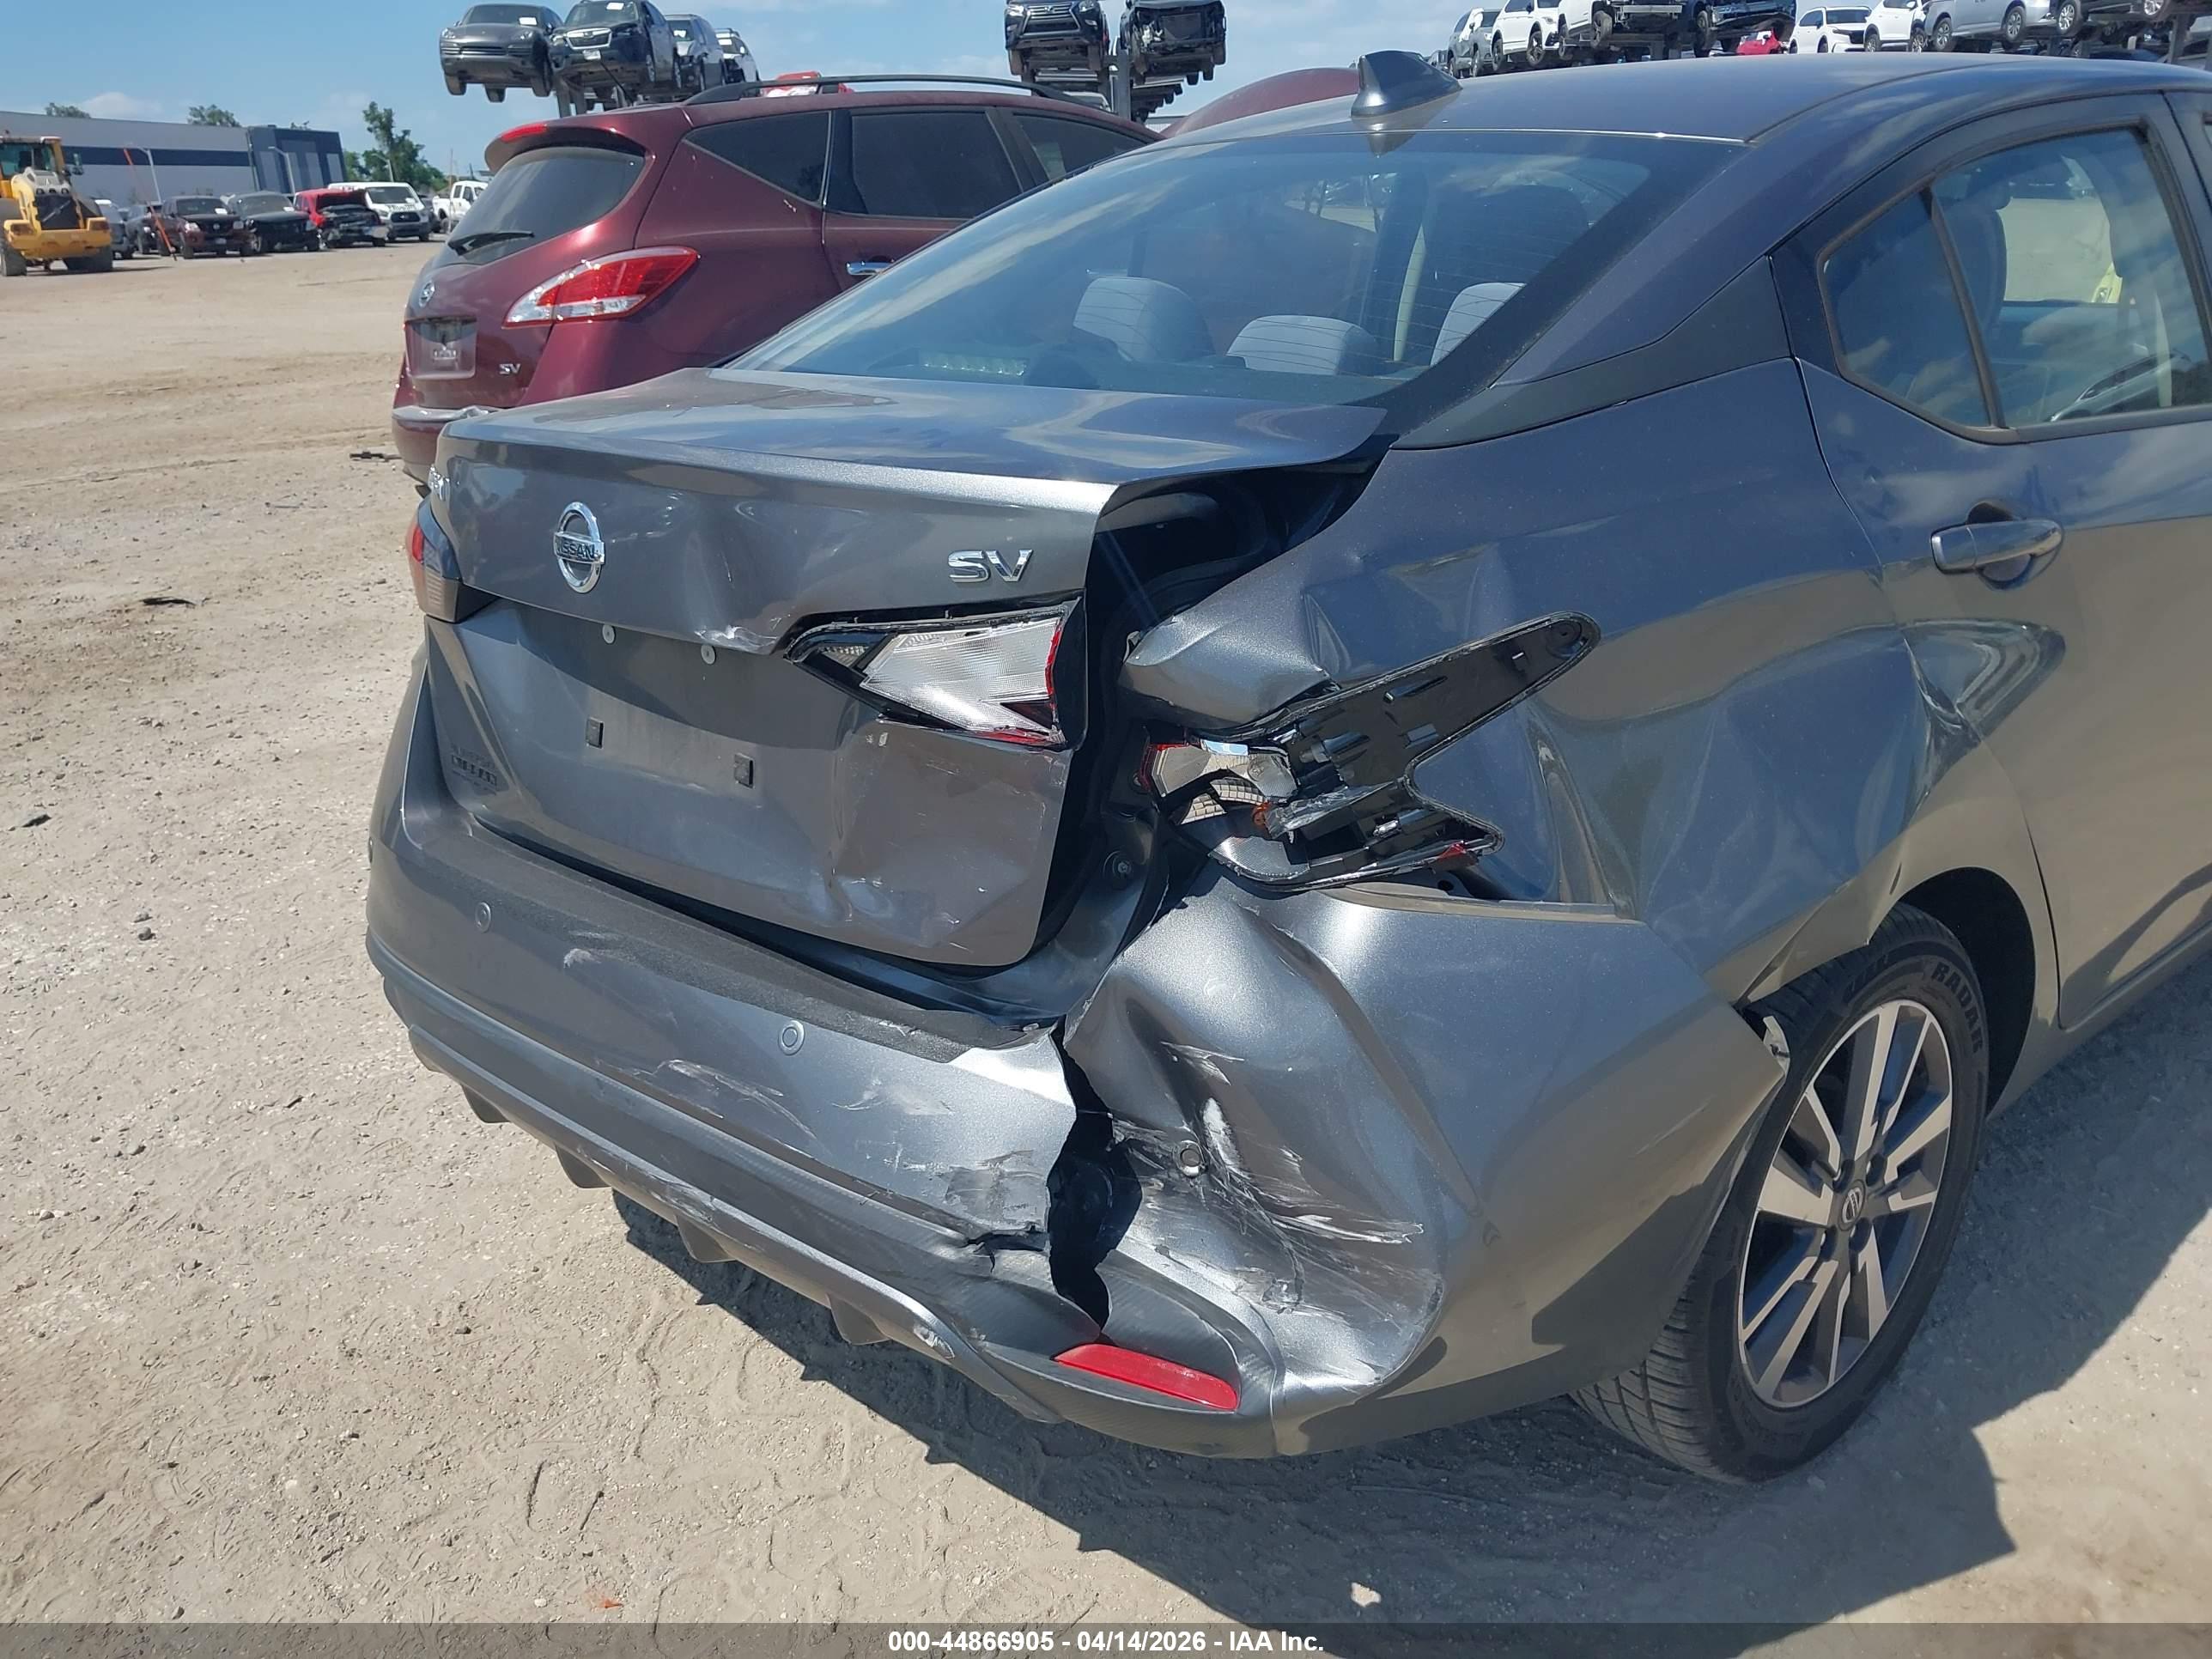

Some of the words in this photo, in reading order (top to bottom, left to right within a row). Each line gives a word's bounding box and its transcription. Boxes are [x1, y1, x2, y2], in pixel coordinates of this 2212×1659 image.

[499, 362, 521, 375] SV
[948, 550, 1033, 582] SV
[1930, 961, 1984, 1054] RADAR
